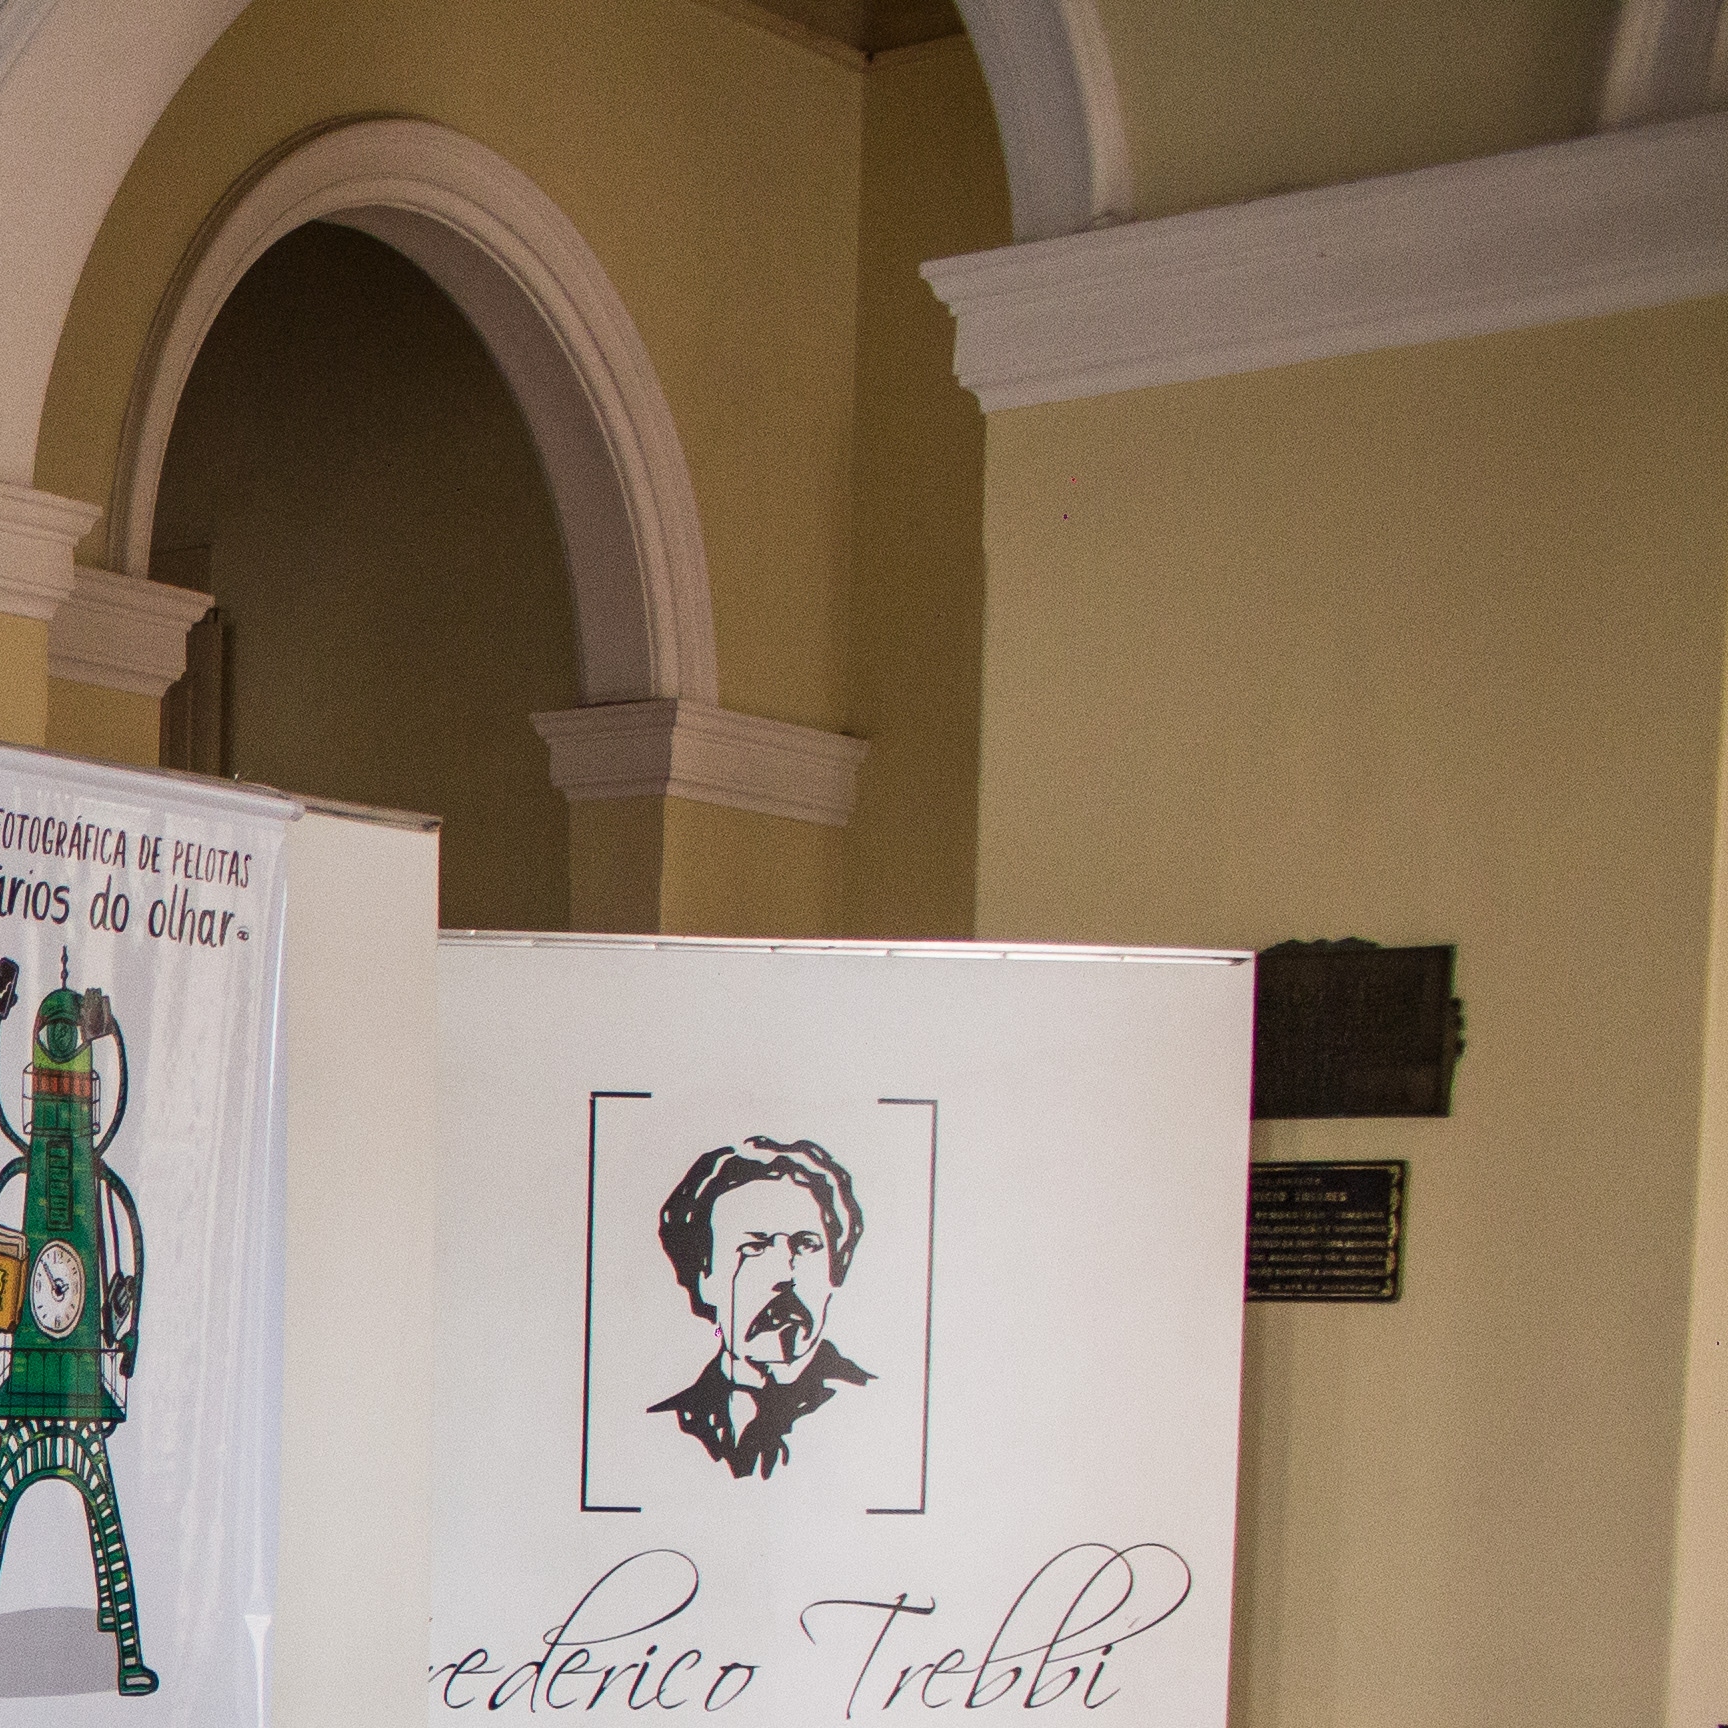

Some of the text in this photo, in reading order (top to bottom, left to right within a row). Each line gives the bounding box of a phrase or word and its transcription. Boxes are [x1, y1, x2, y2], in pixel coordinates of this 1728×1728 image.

[138, 833, 163, 874] DE
[172, 840, 253, 889] PELOTAS
[89, 874, 130, 933] do
[148, 884, 235, 948] olhar
[798, 1542, 1193, 1720] Trebbi
